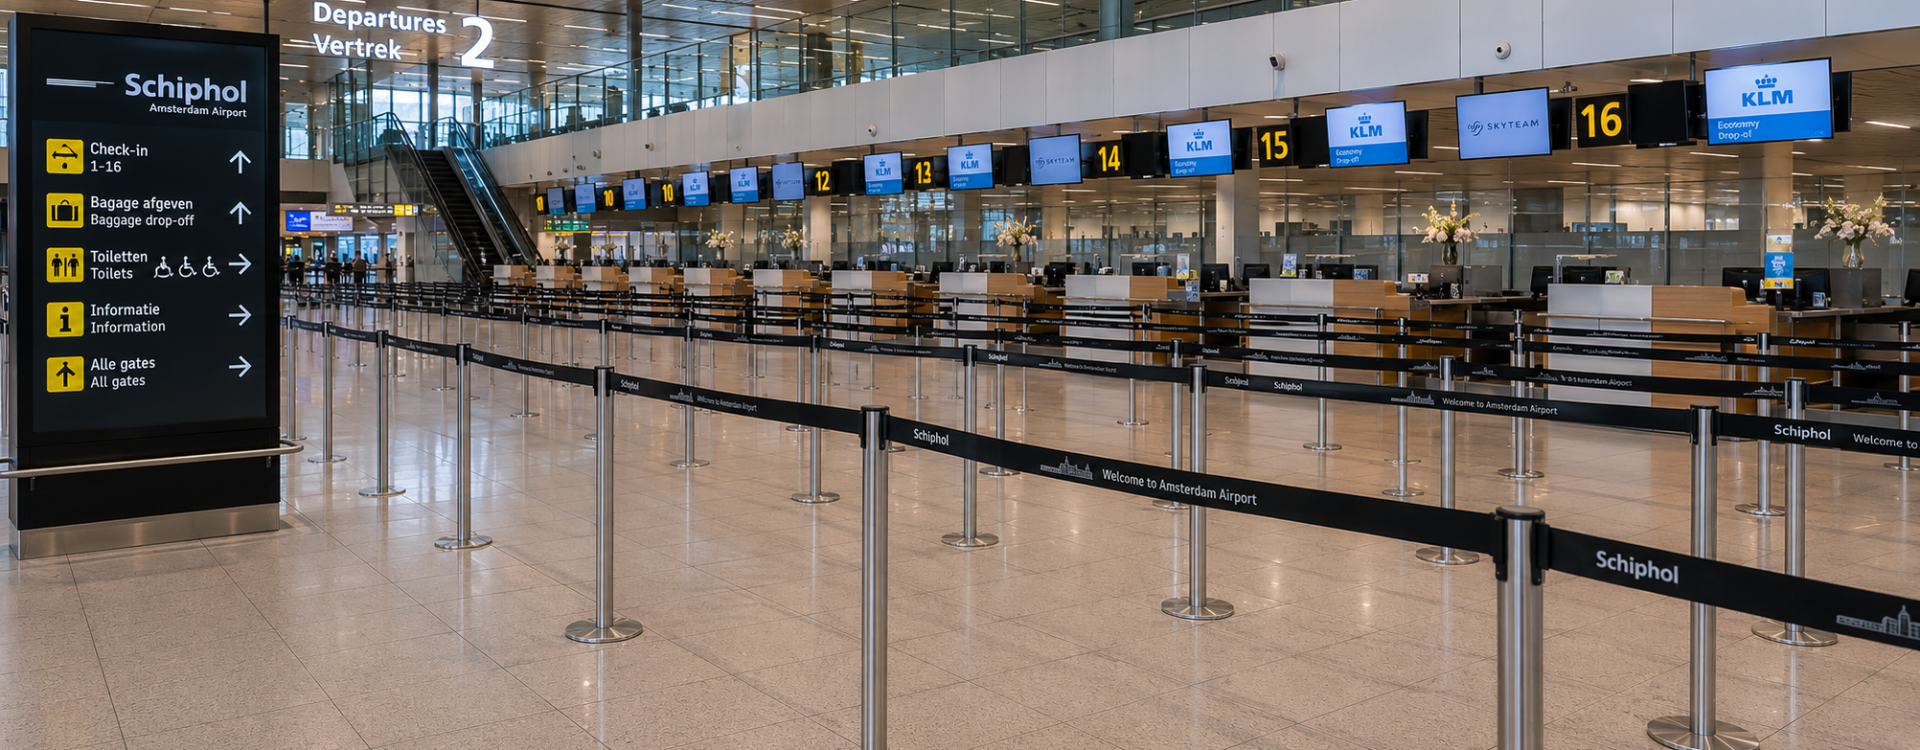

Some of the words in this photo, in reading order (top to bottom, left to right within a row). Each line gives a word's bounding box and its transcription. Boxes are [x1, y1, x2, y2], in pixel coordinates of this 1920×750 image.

[313, 1, 447, 34] Departures
[313, 33, 402, 60] Vertrek
[460, 16, 495, 69] 2
[125, 73, 247, 105] Schiphol
[1742, 90, 1793, 107] KLM
[149, 103, 209, 116] Amsterdam
[211, 107, 247, 118] Airport
[1487, 118, 1540, 131] SKYTEAM
[1580, 101, 1623, 138] 16
[1350, 125, 1383, 138] KLM
[90, 142, 148, 157] Check-in
[1186, 140, 1213, 152] KLM
[1260, 130, 1289, 160] 15
[91, 160, 122, 172] 1-16
[960, 160, 979, 170] KLM
[1098, 145, 1120, 172] 14
[875, 167, 891, 176] KLM
[915, 161, 932, 184] 13
[815, 170, 830, 191] 12
[603, 189, 614, 206] 10
[662, 184, 674, 202] 10
[91, 195, 139, 212] Bagage
[143, 197, 193, 212] afgeven
[91, 213, 142, 228] Baggage
[145, 214, 195, 228] drop-off
[90, 250, 148, 263] Toiletten
[90, 267, 133, 280] Toilets
[91, 303, 160, 317] Informatie
[91, 320, 166, 334] Information
[91, 357, 116, 371] Alle
[120, 357, 156, 373] gates
[91, 375, 108, 388] All
[112, 375, 146, 390] gates
[1442, 397, 1475, 407] Welcome
[1476, 400, 1485, 408] to
[1486, 401, 1528, 412] Amsterdam
[1530, 405, 1558, 415] Airport
[913, 428, 949, 446] Schiphol
[1774, 424, 1831, 440] Schiphol
[1853, 433, 1903, 448] Welcome
[1906, 440, 1918, 449] to
[1102, 468, 1145, 487] Welcome
[1147, 478, 1157, 489] to
[1159, 479, 1216, 499] Amsterdam
[1218, 489, 1257, 506] Airport
[1596, 550, 1679, 584] Schiphol
